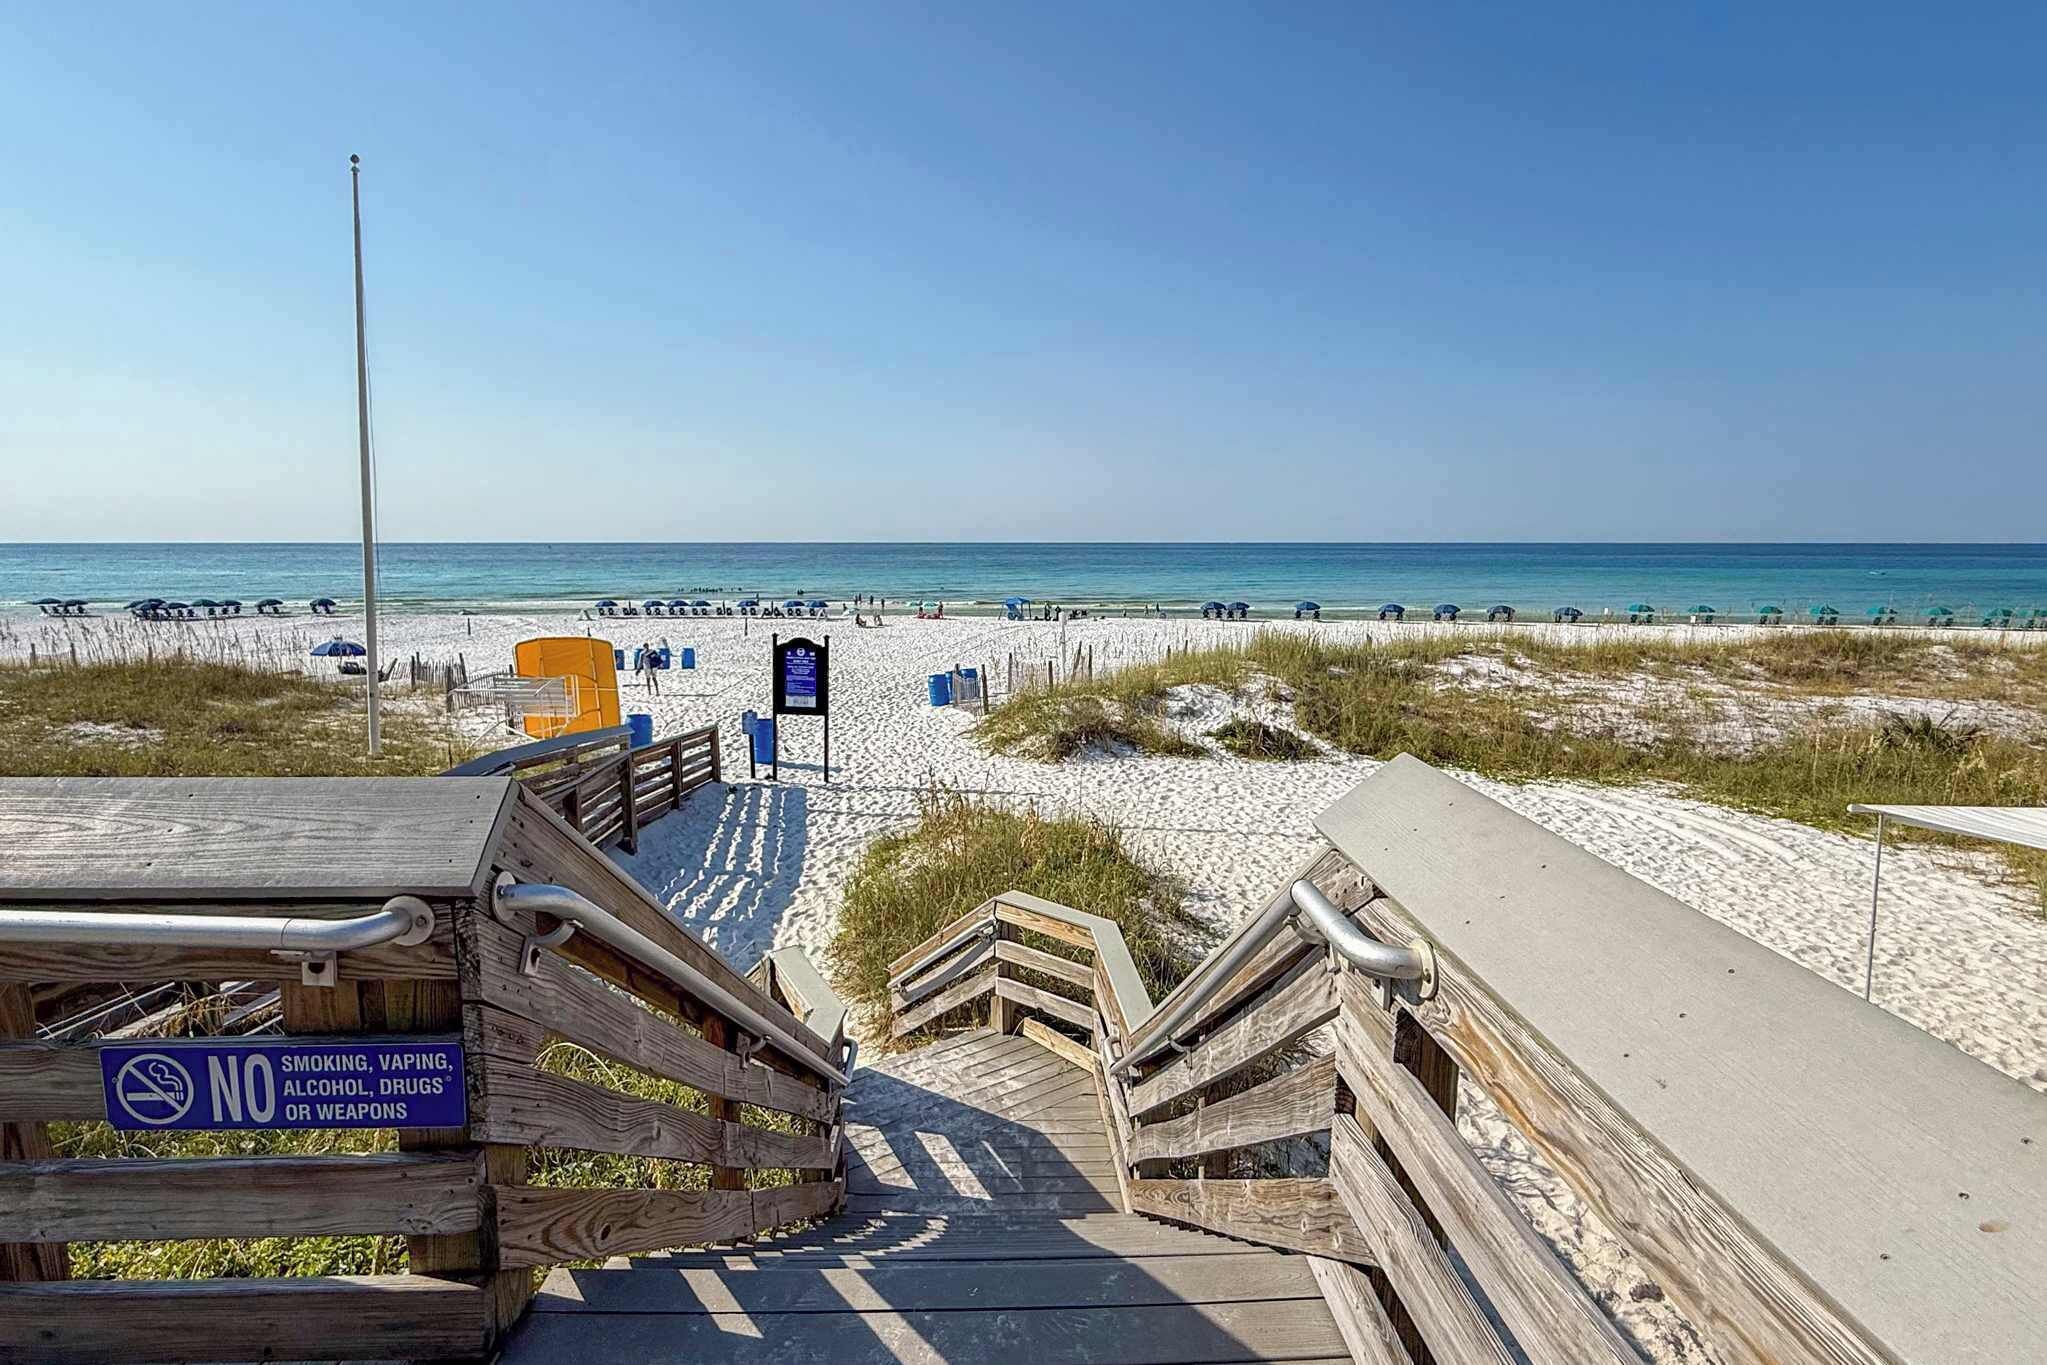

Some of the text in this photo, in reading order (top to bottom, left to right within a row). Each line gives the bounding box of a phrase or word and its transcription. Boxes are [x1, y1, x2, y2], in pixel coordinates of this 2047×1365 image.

[281, 1053, 454, 1074] SMOKING, VAPING,
[208, 1053, 276, 1123] NO
[283, 1077, 444, 1098] ALCOHOL, DRUGS
[285, 1102, 408, 1121] OR WEAPONS
